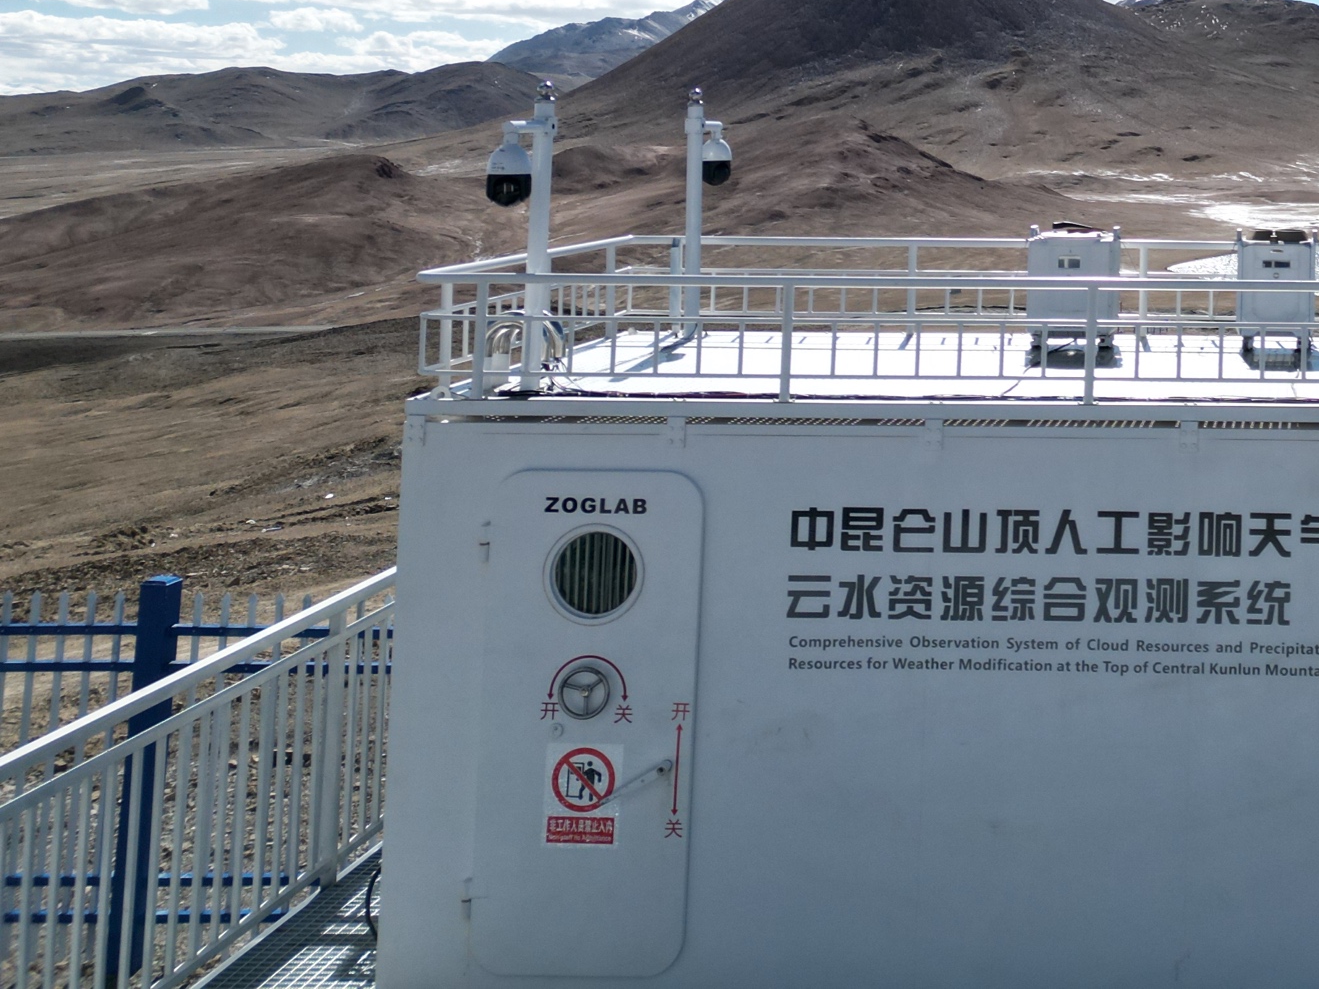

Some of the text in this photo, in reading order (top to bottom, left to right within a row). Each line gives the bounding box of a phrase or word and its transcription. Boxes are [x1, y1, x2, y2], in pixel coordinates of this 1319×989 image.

[544, 497, 647, 514] ZOGLAB
[786, 573, 1292, 626] 云水资源综合观测系统
[788, 635, 904, 651] Comprehensive
[909, 636, 1000, 650] Observation
[1006, 637, 1059, 653] System
[1065, 638, 1081, 651] of
[1086, 639, 1130, 652] Cloud
[1136, 640, 1210, 653] Resources
[1215, 641, 1243, 654] and
[788, 657, 863, 670] Resources
[866, 657, 889, 670] for
[892, 658, 955, 671] Weather
[958, 659, 1053, 672] Modification
[1056, 661, 1072, 673] at
[1074, 661, 1099, 673] the
[1102, 661, 1130, 676] Top
[1133, 662, 1149, 674] of
[1152, 662, 1205, 675] Central
[1209, 663, 1261, 676] Kunlun
[540, 702, 559, 720] 开
[614, 704, 633, 723] 关
[671, 702, 690, 721] 开
[550, 818, 613, 834] 非工作人员禁止入内
[664, 819, 683, 838] 关
